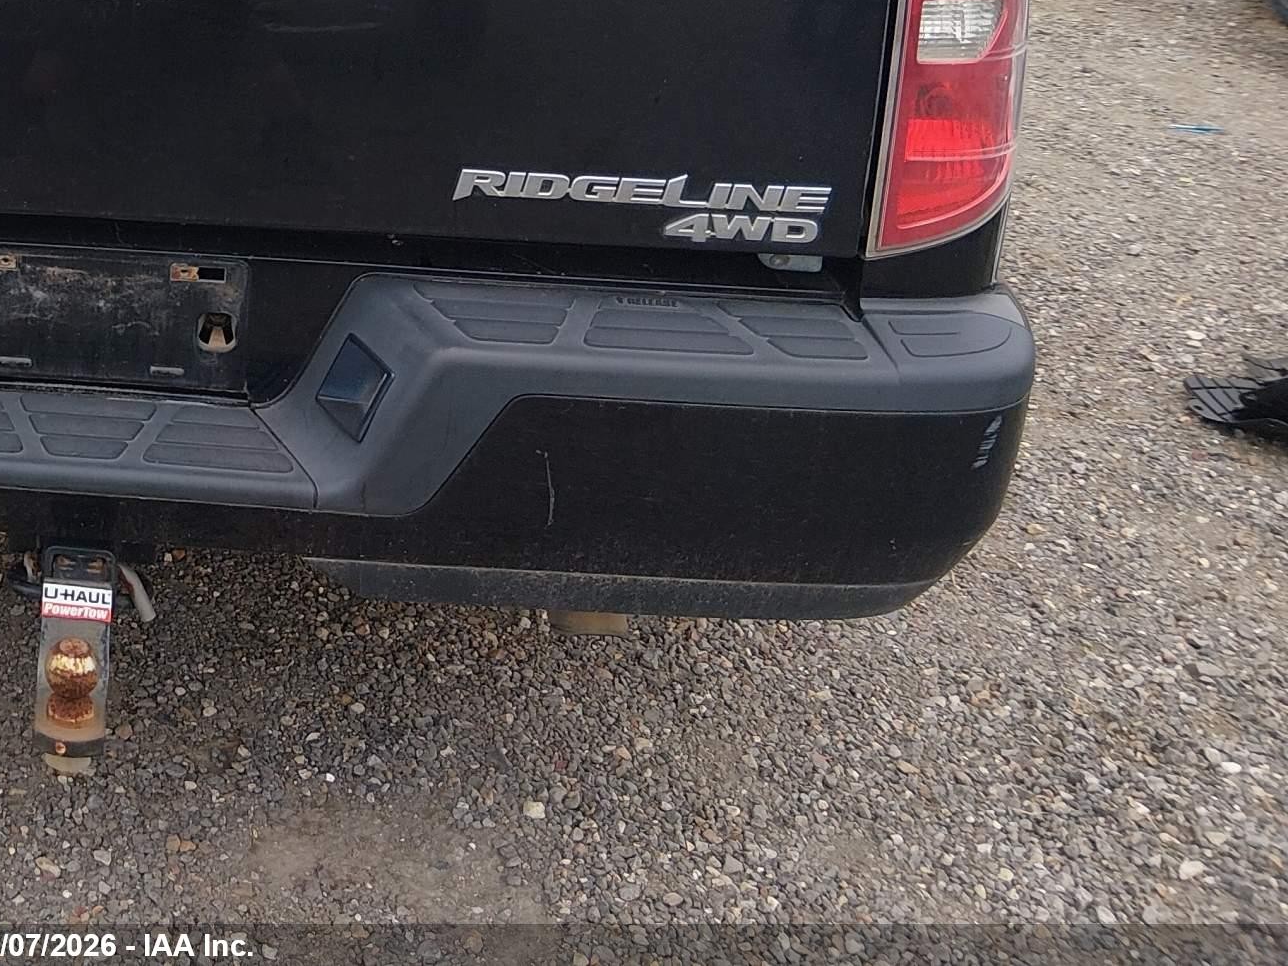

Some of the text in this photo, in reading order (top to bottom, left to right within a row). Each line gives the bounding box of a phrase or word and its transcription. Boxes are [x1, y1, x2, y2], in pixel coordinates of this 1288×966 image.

[452, 168, 832, 213] RIDGELINE
[663, 213, 819, 244] 4WD
[44, 586, 111, 605] U-HAUL
[43, 602, 109, 620] PowerTow
